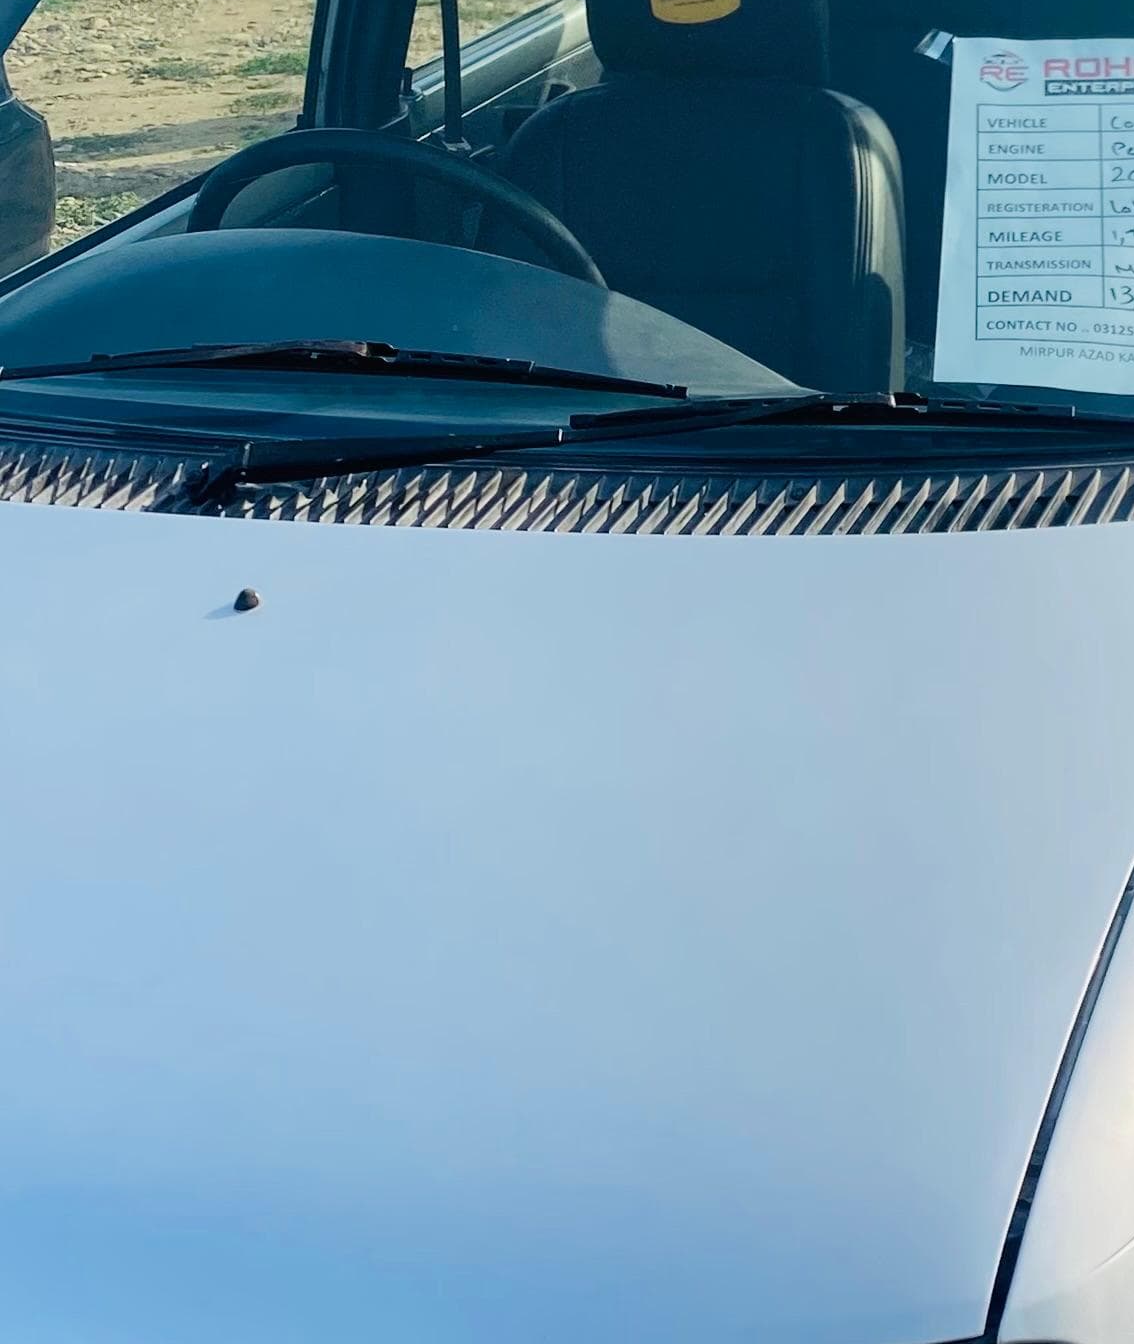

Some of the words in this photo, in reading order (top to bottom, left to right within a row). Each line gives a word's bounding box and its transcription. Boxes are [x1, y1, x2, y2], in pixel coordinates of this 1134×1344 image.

[987, 118, 1047, 129] VEHICLE
[989, 144, 1045, 155] ENGINE
[987, 173, 1048, 185] MODEL
[986, 202, 1094, 214] REGISTERATION
[989, 231, 1063, 242] MILEAGE
[986, 259, 1092, 270] TRANSMISSION
[987, 290, 1073, 303] DEMAND
[986, 320, 1050, 331] CONTACT
[1056, 322, 1078, 332] NO
[1020, 346, 1075, 358] MIRPUR
[1078, 349, 1115, 362] AZAD
